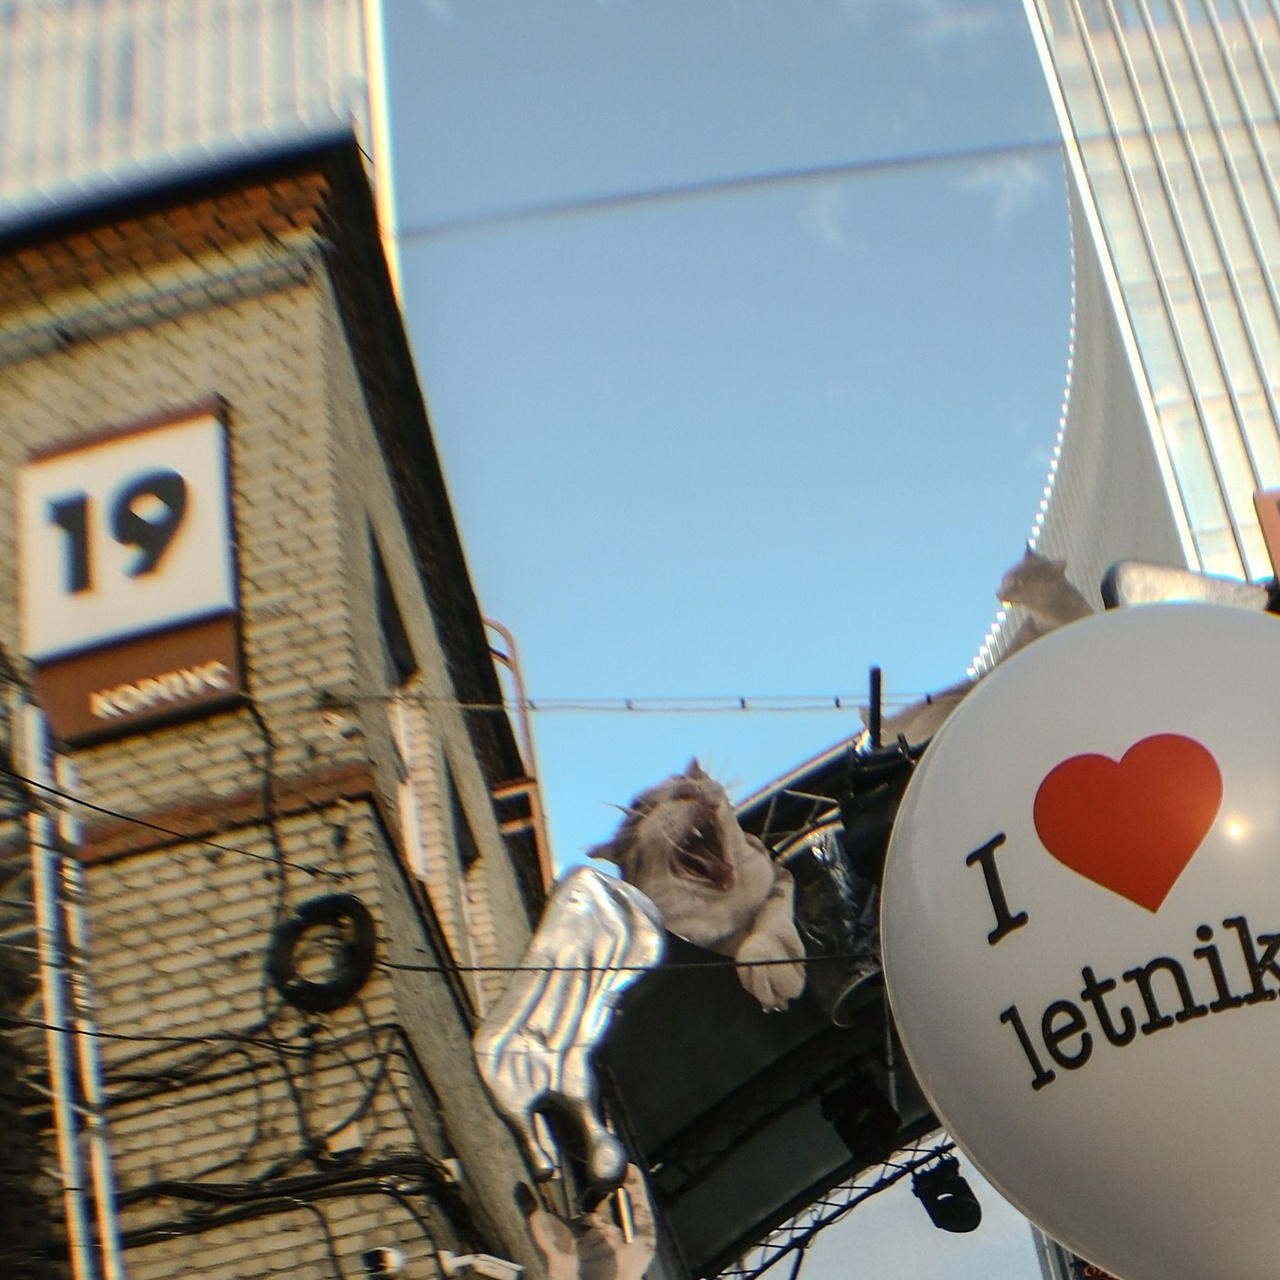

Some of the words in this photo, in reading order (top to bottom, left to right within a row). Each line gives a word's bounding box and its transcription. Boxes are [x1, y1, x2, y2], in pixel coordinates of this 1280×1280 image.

[46, 466, 192, 597] 19
[90, 659, 232, 720] КОРПУС
[965, 832, 1029, 946] I
